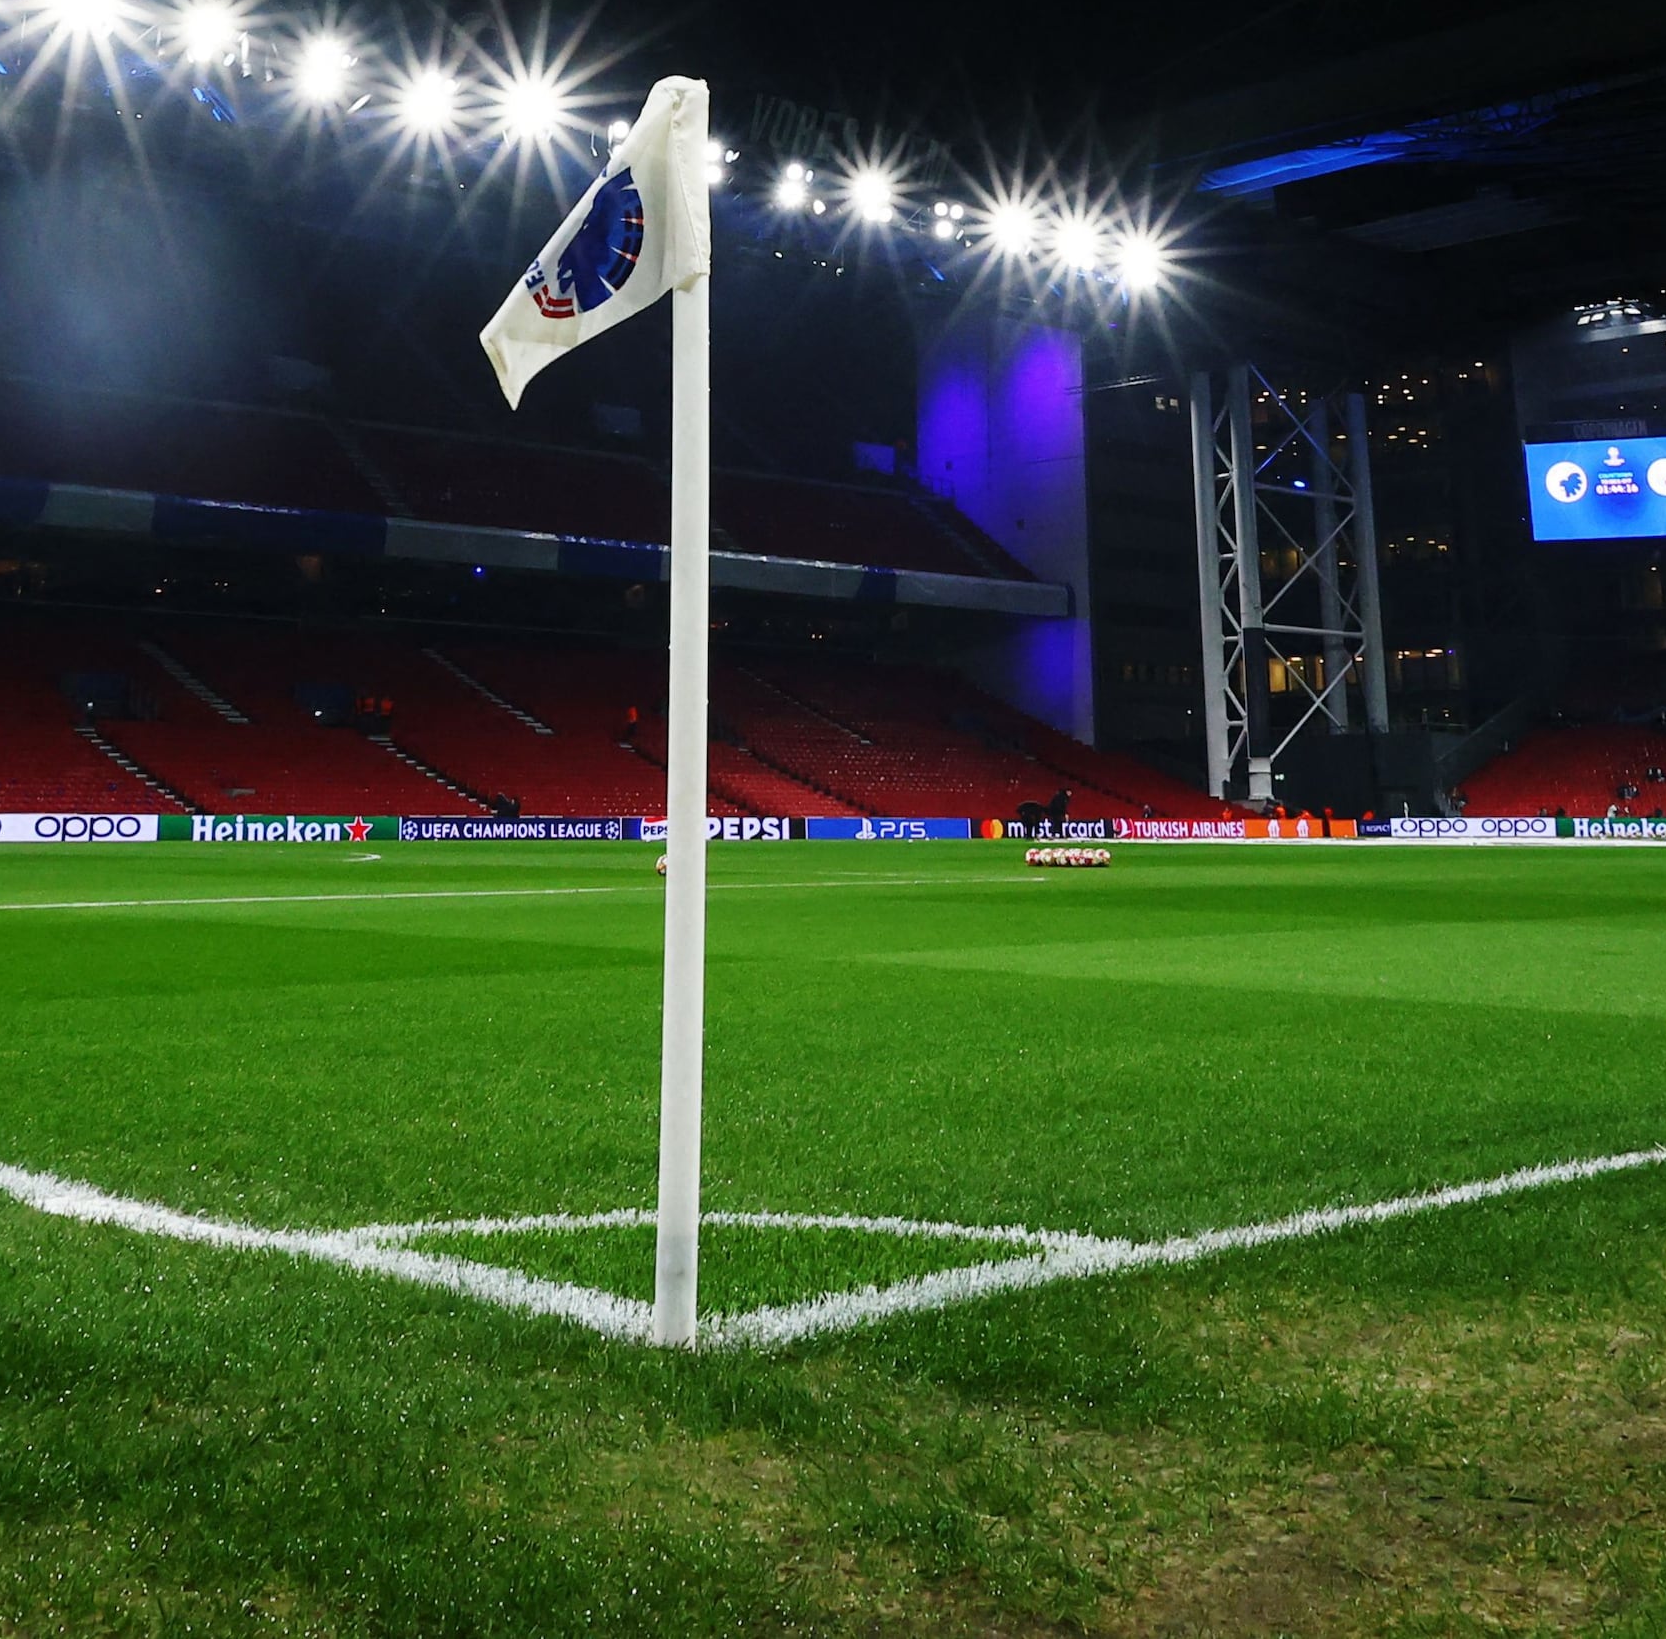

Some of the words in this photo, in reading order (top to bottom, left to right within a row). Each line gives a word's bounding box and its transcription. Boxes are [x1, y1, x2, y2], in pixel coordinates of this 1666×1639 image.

[35, 815, 141, 842] oppo
[191, 815, 341, 842] Heineken
[421, 822, 460, 839] UEFA
[463, 822, 547, 839] CHAMPIONS
[549, 822, 603, 839] LEAGUE
[643, 825, 668, 836] PEPS
[705, 817, 790, 840] PEPSI
[880, 821, 927, 839] PS5
[1008, 818, 1105, 838] mstrcard
[1134, 820, 1189, 838] TURKISH
[1192, 819, 1244, 838] AIRLINES
[1400, 818, 1467, 837] oppo
[1481, 818, 1547, 837] oppo
